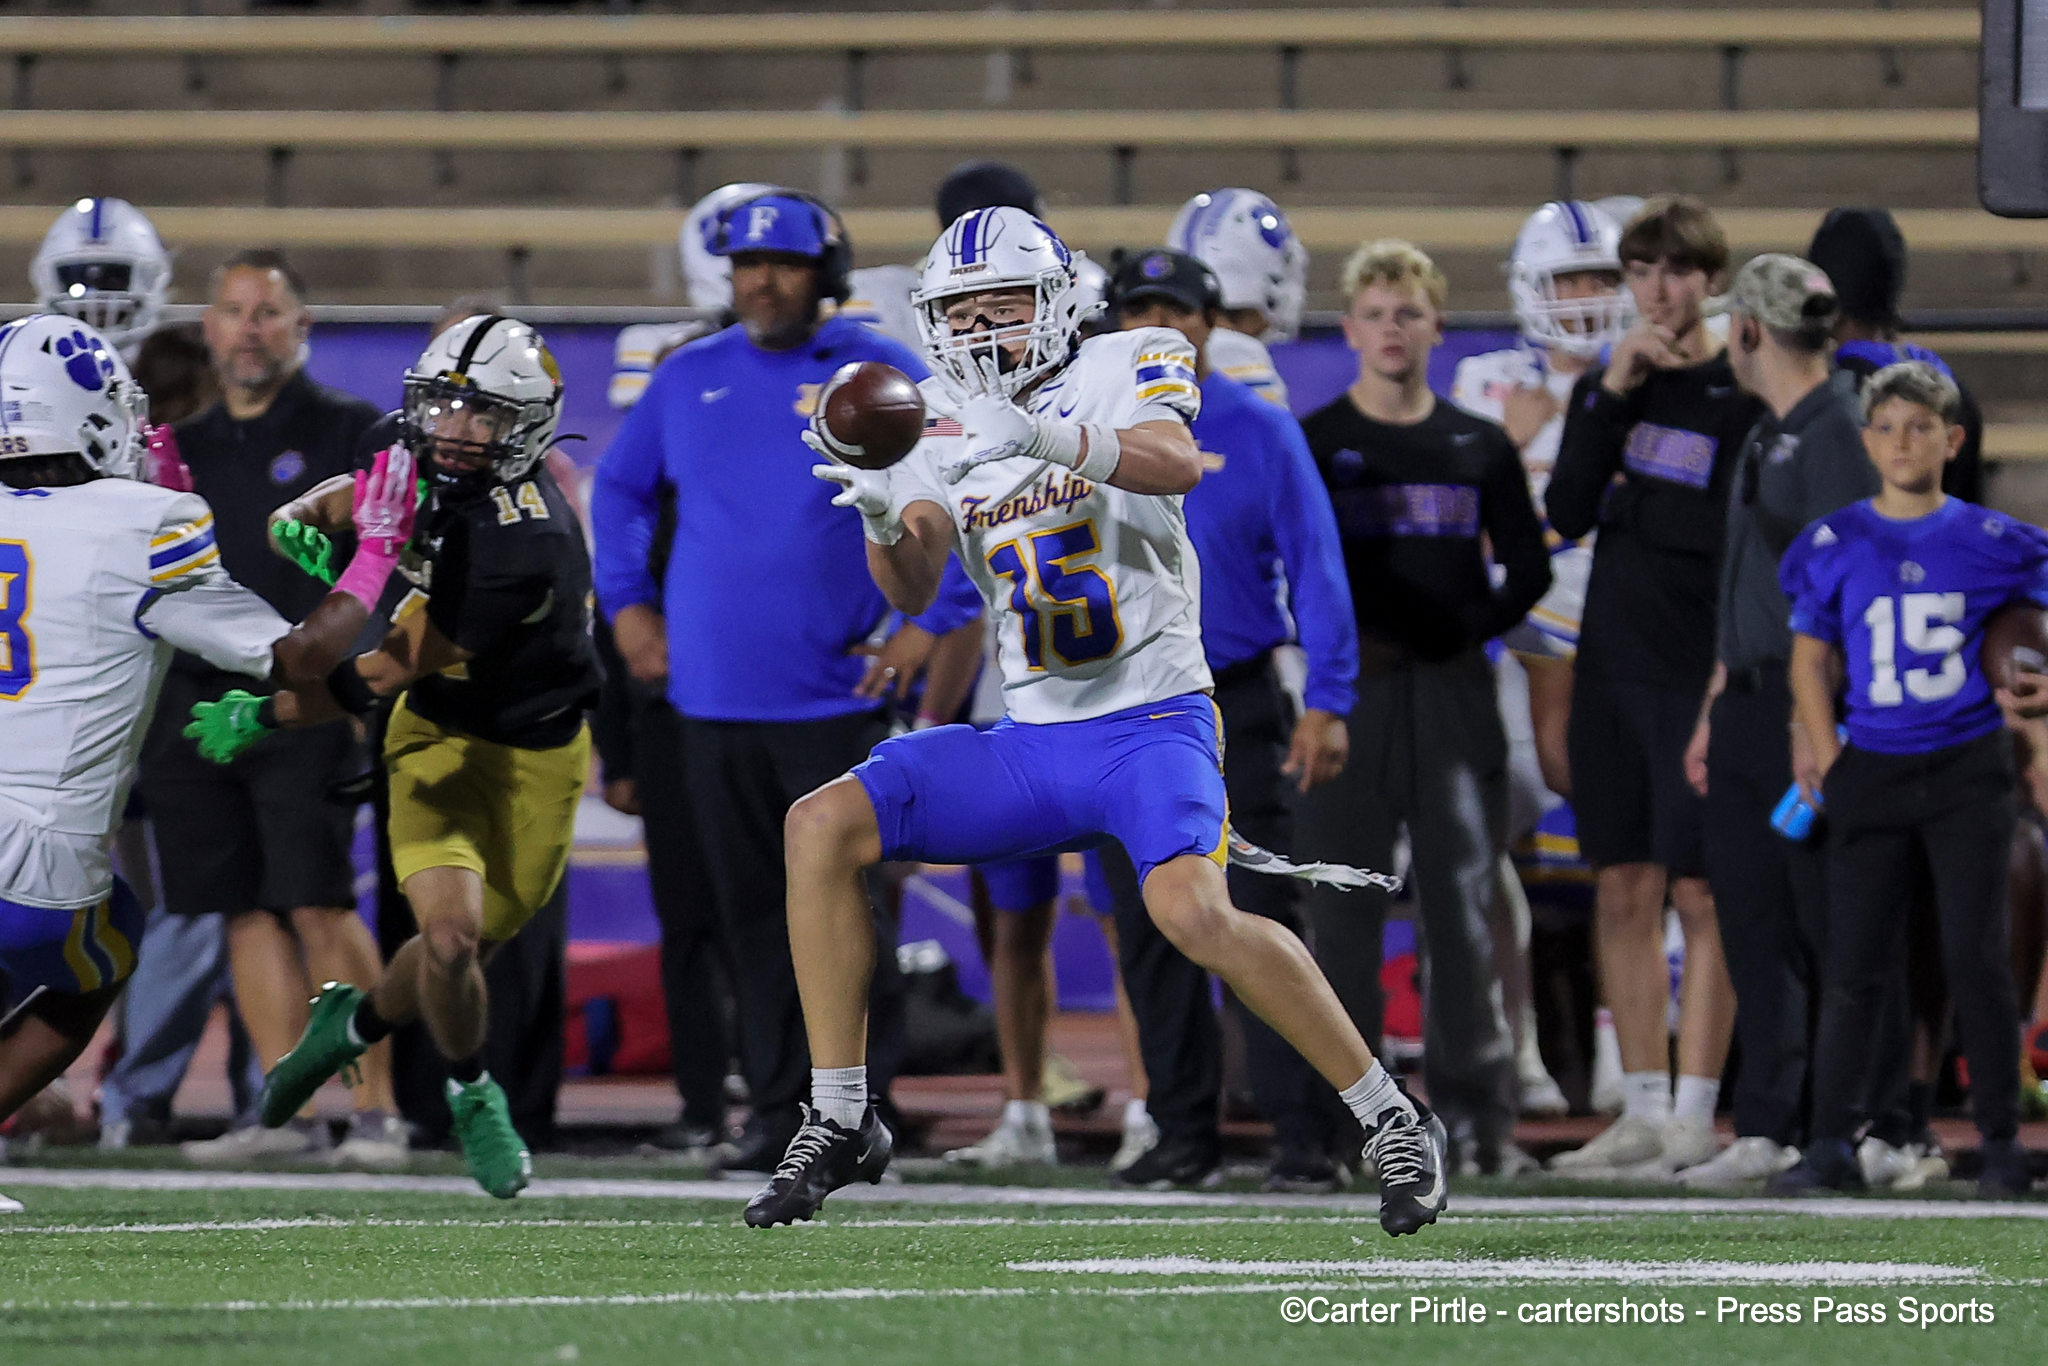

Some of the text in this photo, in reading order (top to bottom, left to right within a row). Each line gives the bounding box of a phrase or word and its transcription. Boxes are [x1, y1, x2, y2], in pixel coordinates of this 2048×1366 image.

[746, 206, 780, 242] F
[489, 480, 551, 527] 14
[960, 472, 1095, 534] Frenship
[984, 517, 1125, 672] 15
[1864, 591, 1967, 708] 15
